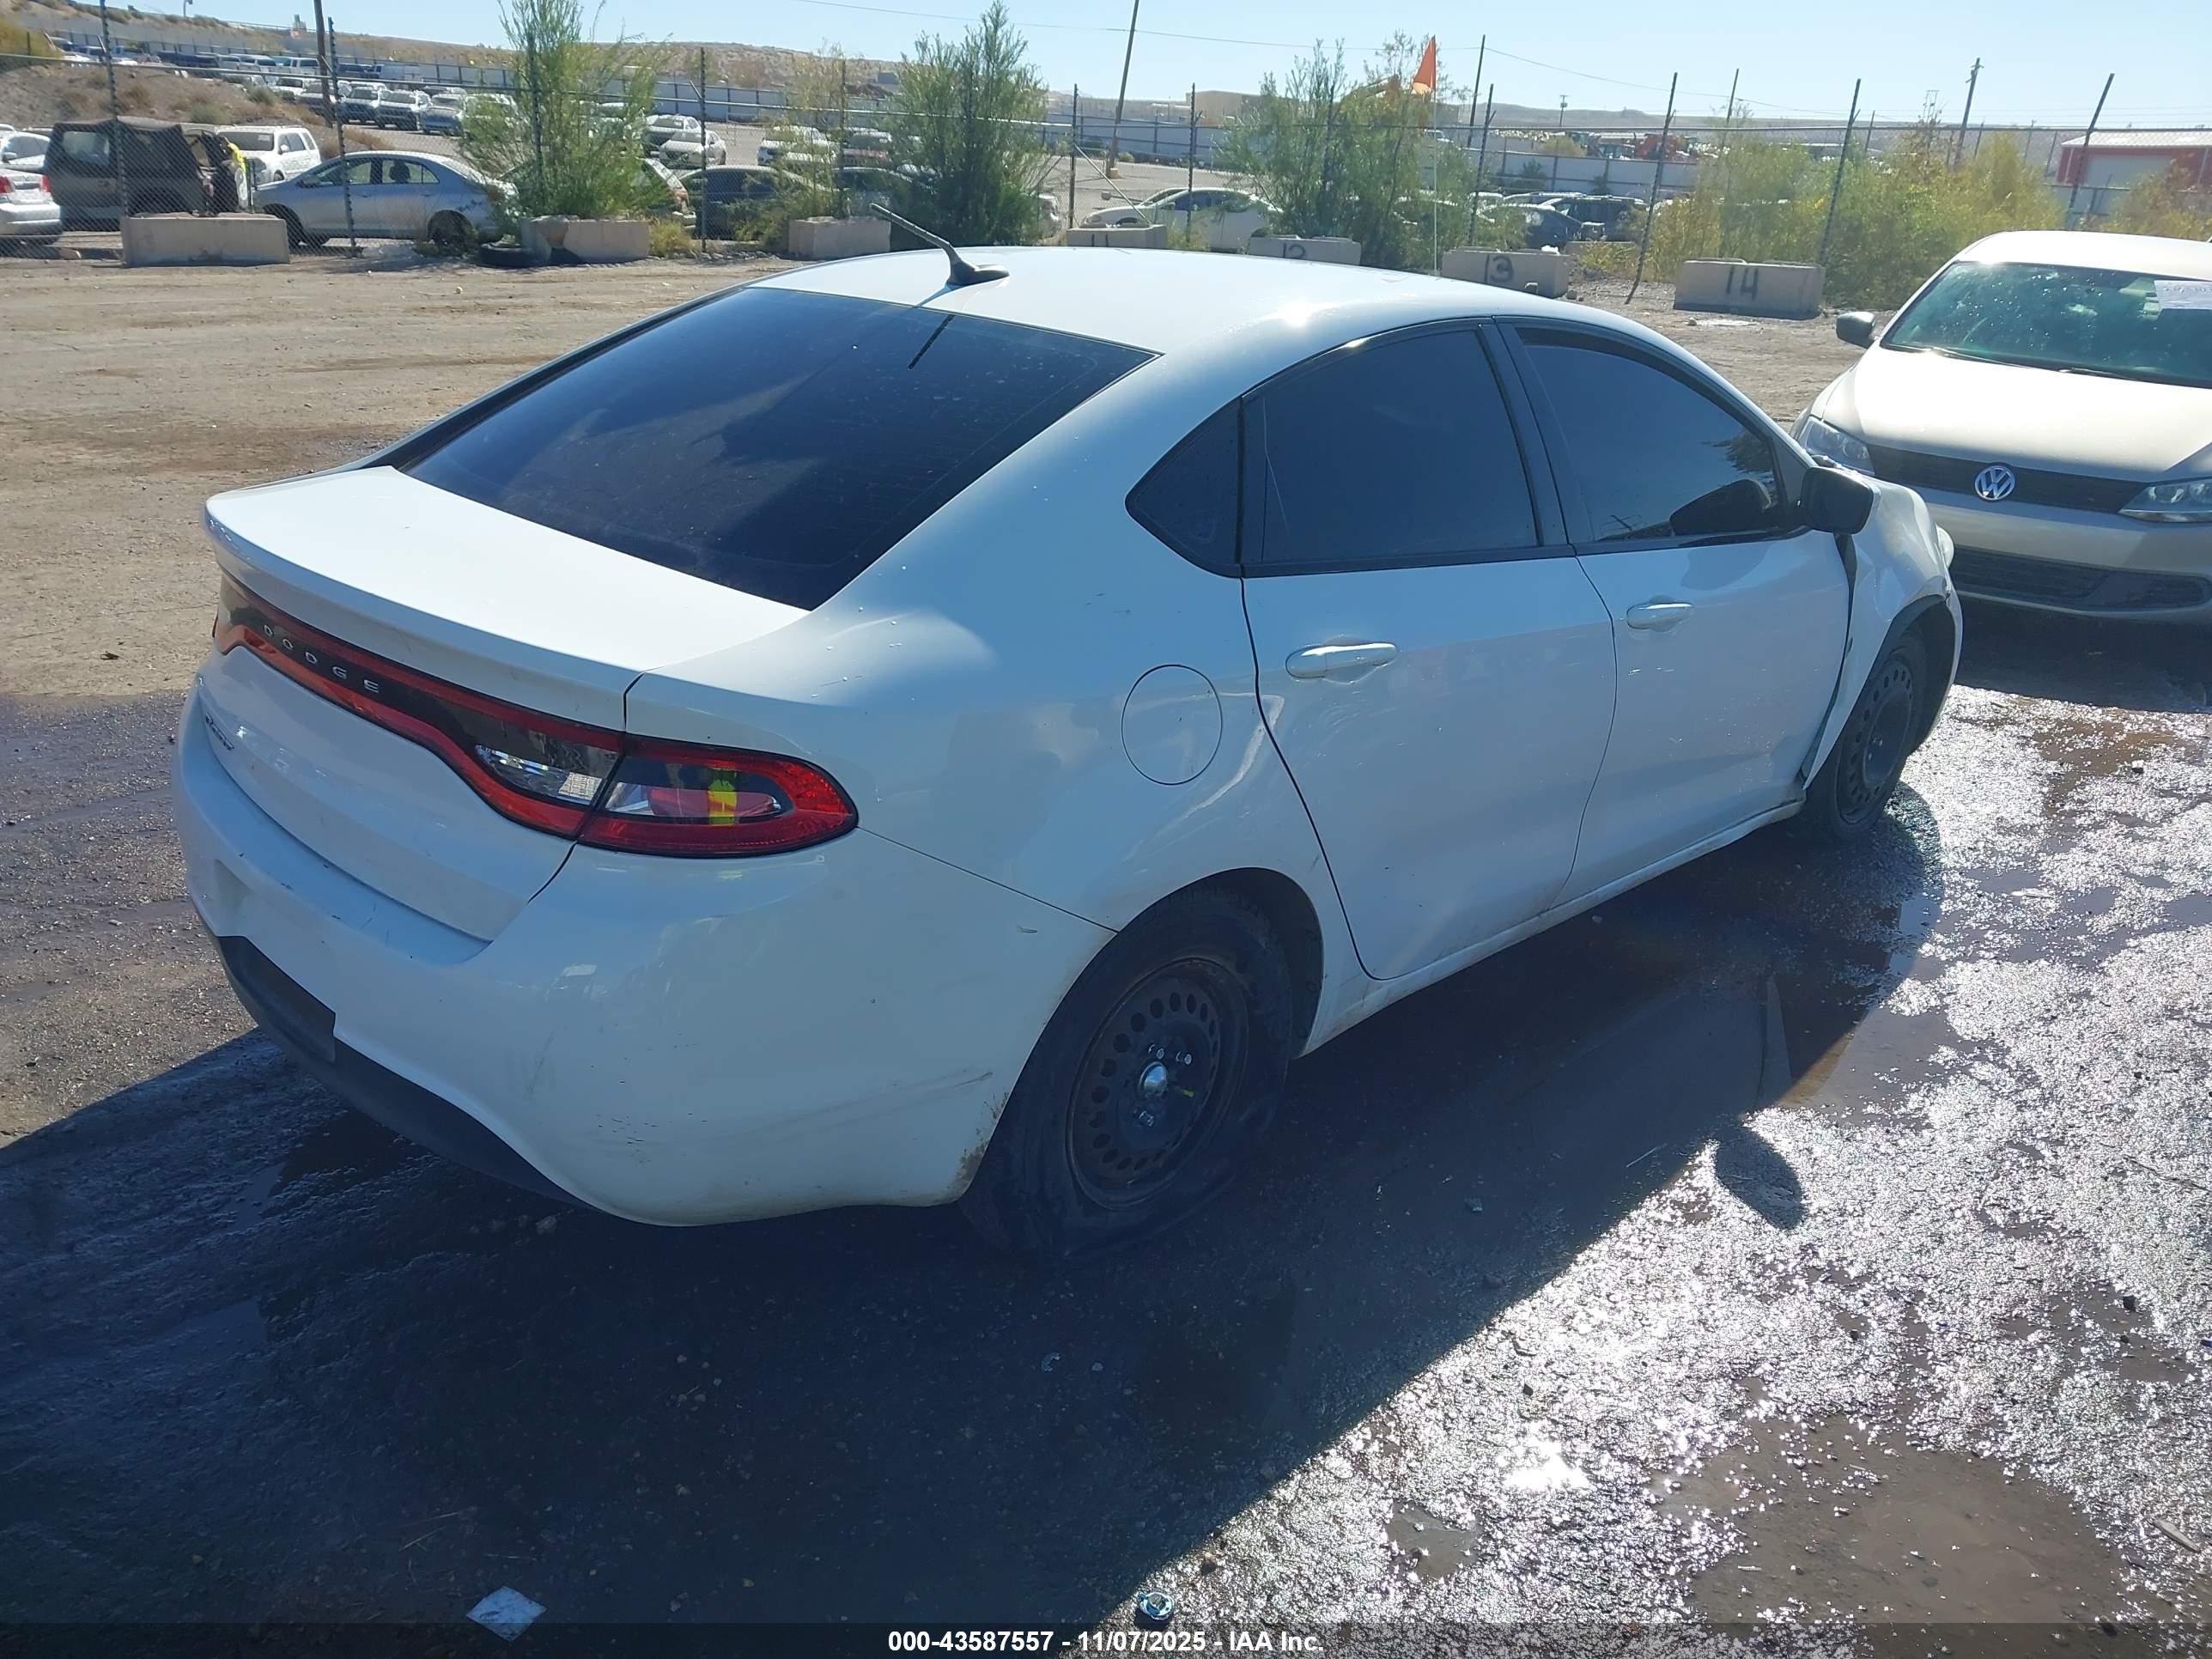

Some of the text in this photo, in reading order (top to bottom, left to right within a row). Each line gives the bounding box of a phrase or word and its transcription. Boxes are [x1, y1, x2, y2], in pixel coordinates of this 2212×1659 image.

[1282, 243, 1306, 259] 12
[1484, 254, 1515, 284] 13
[1725, 265, 1759, 301] 14
[1975, 465, 2015, 501] VW
[264, 624, 379, 693] DODGE
